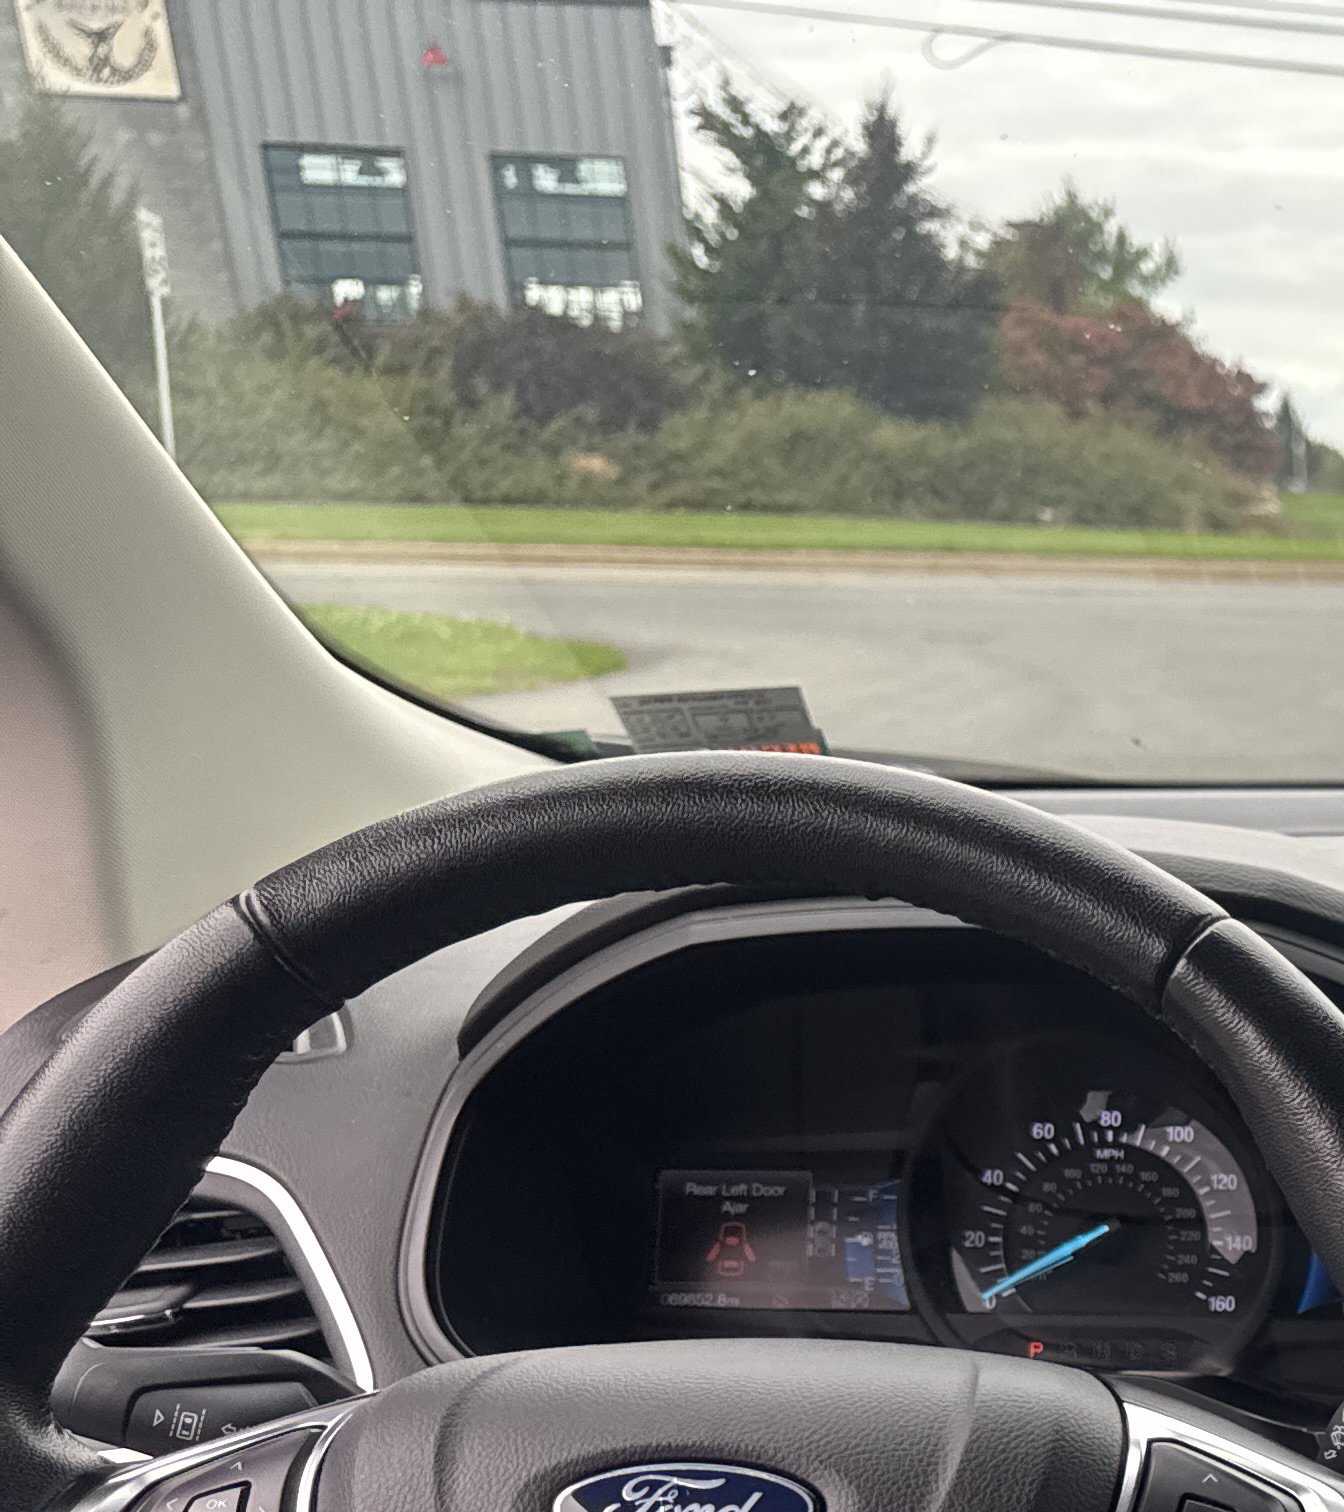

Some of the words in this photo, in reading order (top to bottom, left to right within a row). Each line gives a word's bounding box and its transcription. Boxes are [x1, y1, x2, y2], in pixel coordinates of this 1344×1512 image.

[1100, 1110, 1122, 1128] 80
[1032, 1122, 1055, 1140] 60
[1166, 1125, 1194, 1143] 100
[1096, 1148, 1124, 1161] MPH
[982, 1169, 1003, 1187] 40
[1210, 1174, 1237, 1191] 120
[752, 1183, 786, 1196] Door
[964, 1231, 985, 1248] 20
[1224, 1235, 1252, 1252] 140
[1207, 1296, 1236, 1313] 160
[1030, 1341, 1044, 1358] P
[206, 1498, 227, 1510] OK
